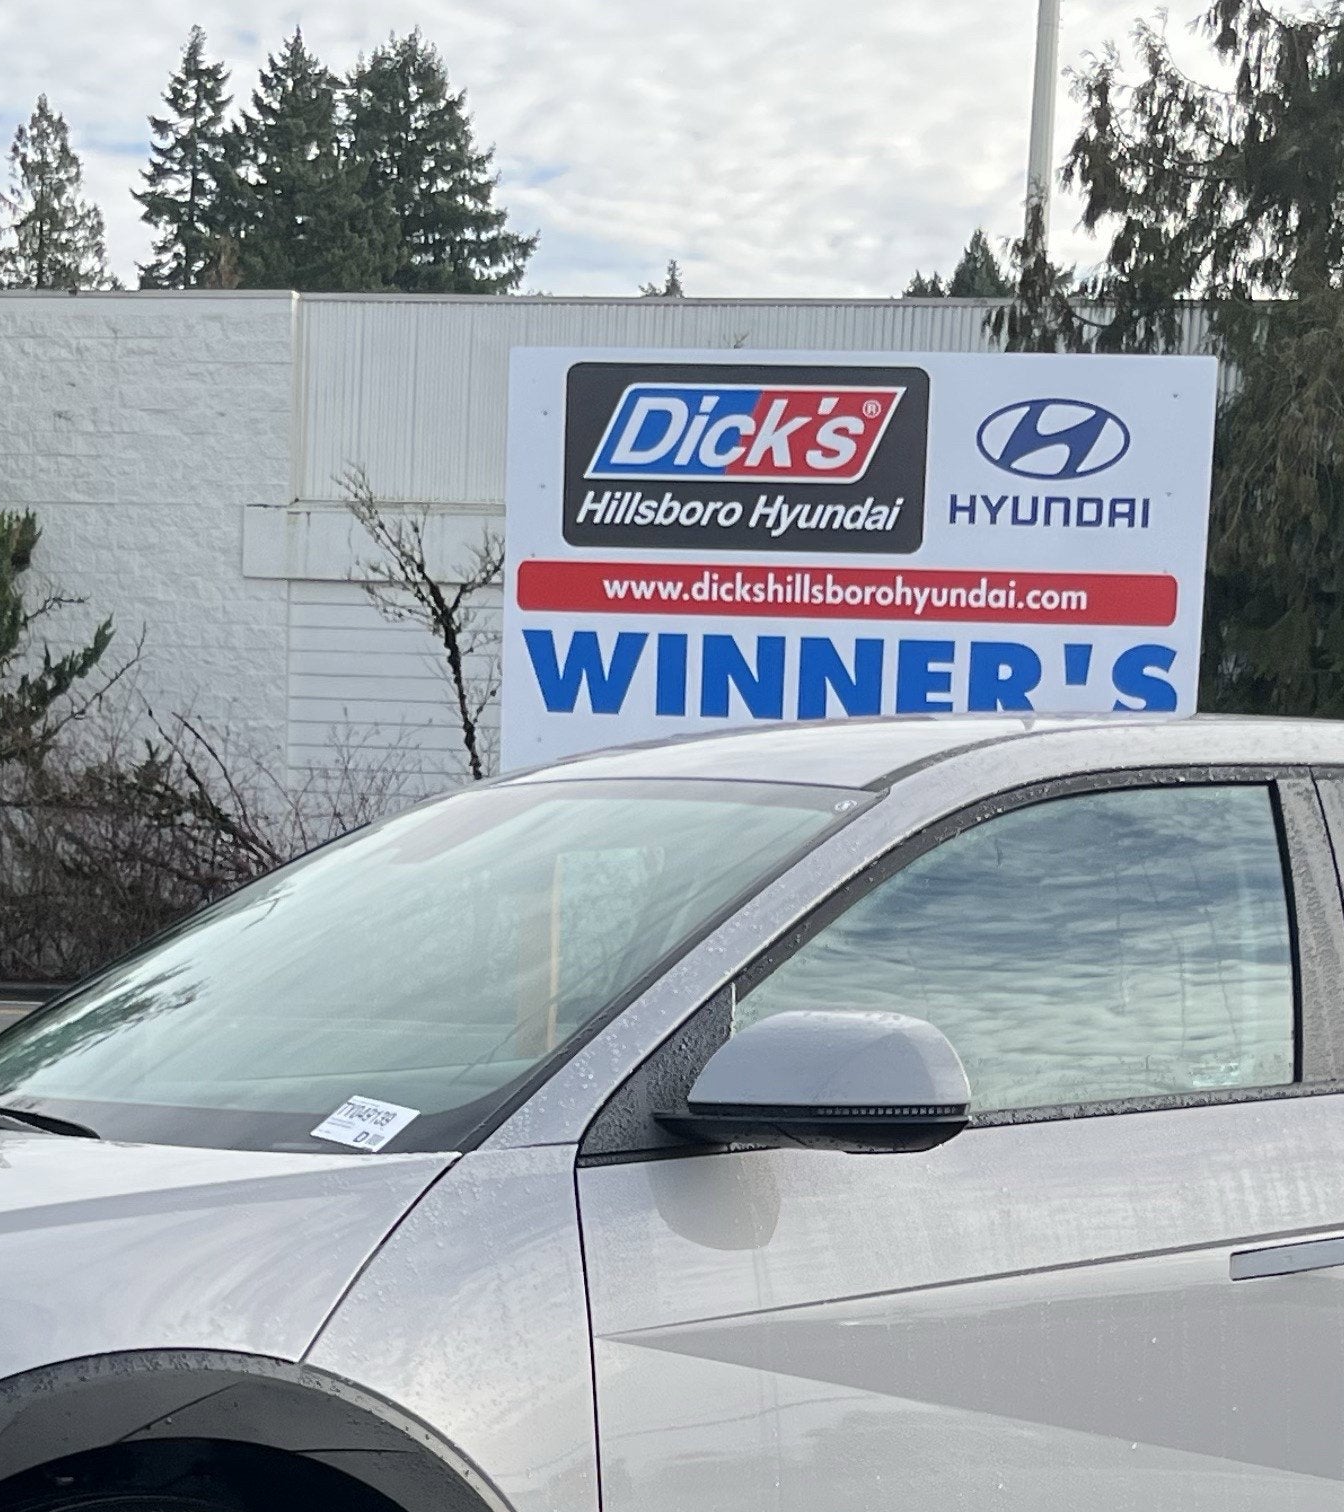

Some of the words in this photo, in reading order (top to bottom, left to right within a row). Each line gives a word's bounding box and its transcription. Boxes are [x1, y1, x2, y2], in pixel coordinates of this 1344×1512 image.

[608, 394, 866, 470] Dick's
[576, 491, 737, 528] Hillsboro
[748, 495, 904, 536] Hyundai
[950, 494, 1150, 528] HYUNDAI
[603, 573, 1088, 614] www.dickshillsborohyundai.com
[522, 629, 1178, 719] WINNER'S
